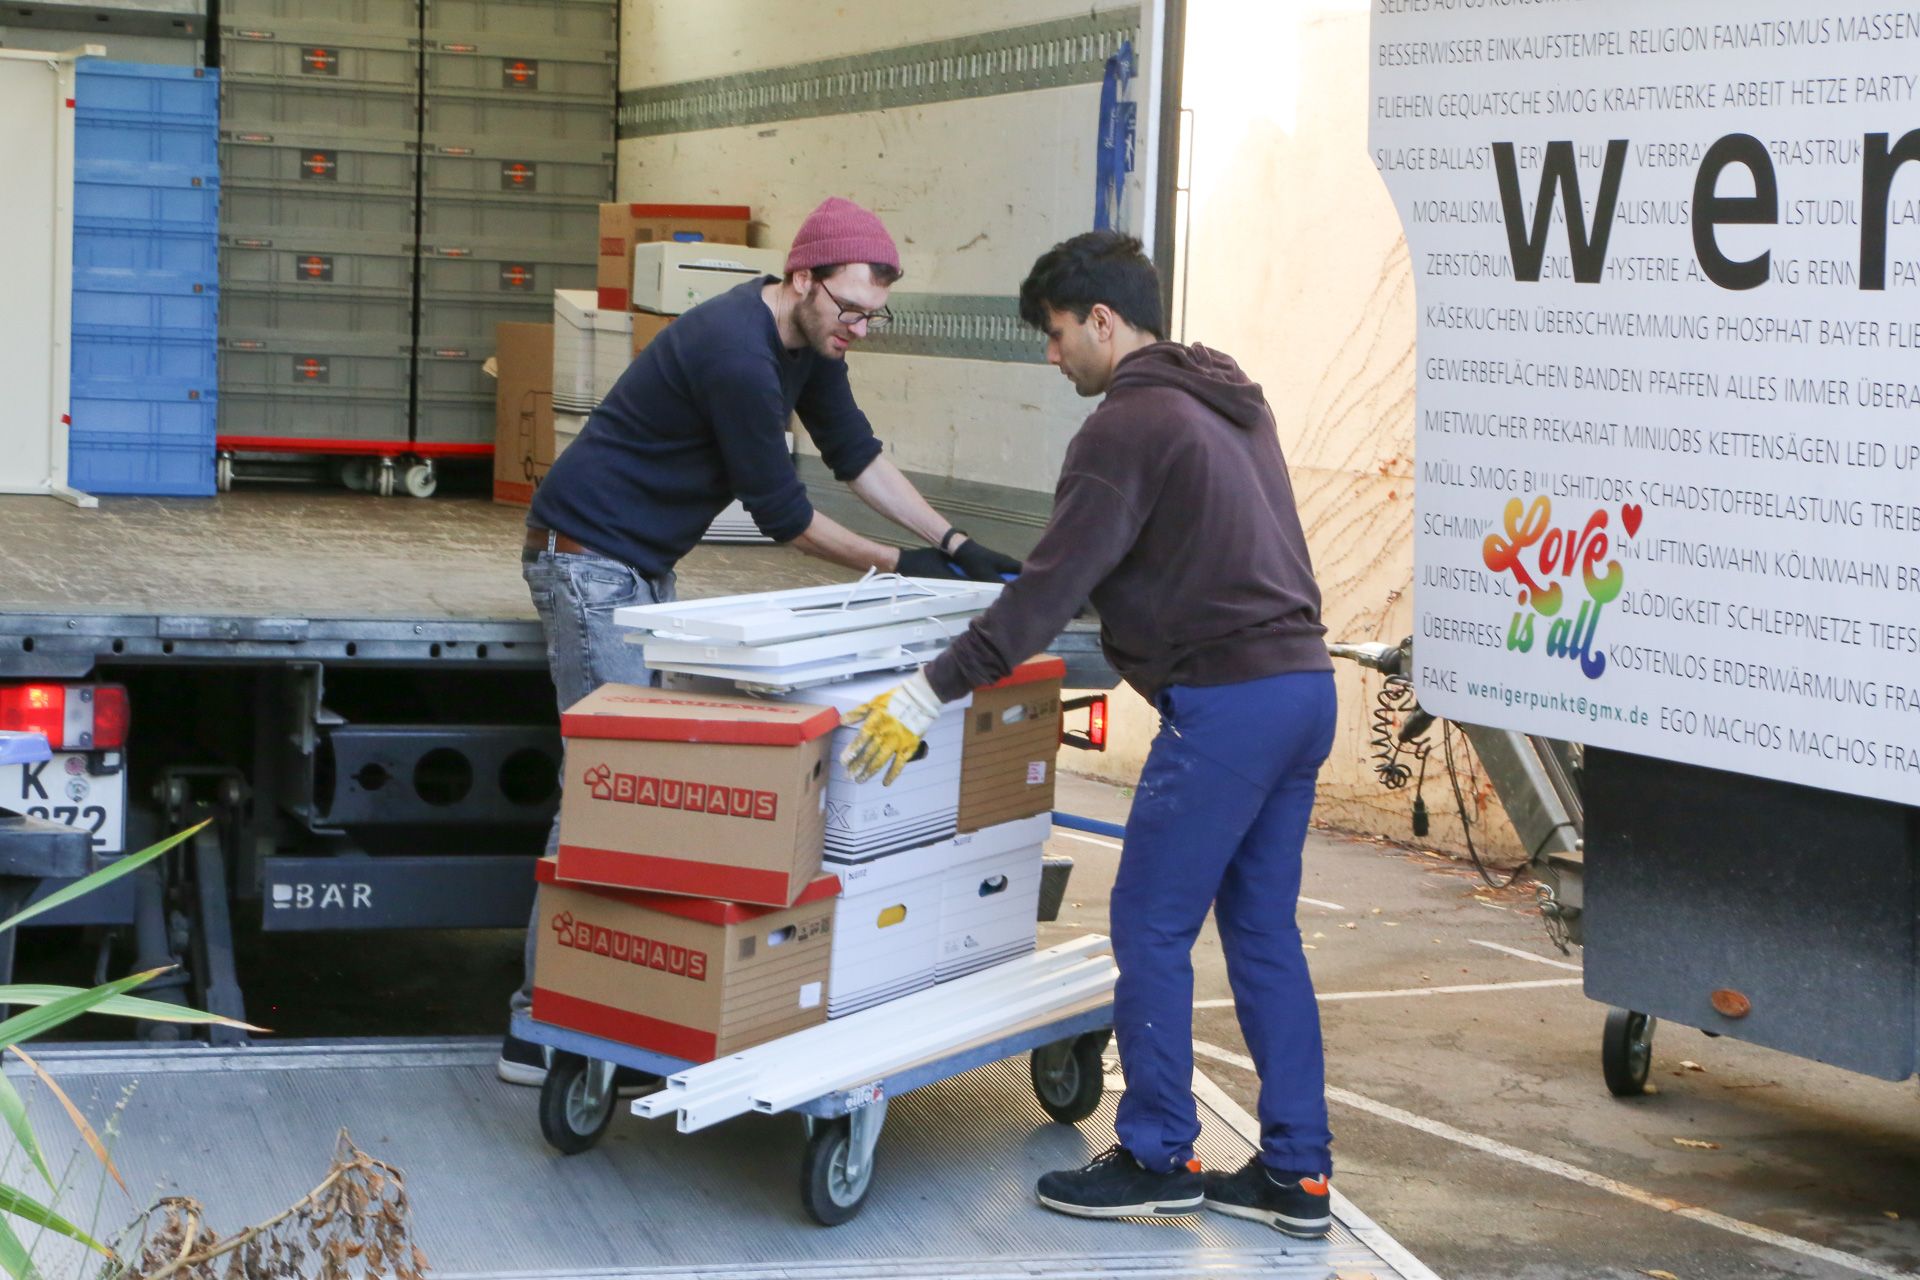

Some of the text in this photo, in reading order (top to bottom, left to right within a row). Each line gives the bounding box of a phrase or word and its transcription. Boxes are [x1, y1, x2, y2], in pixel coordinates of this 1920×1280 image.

[1378, 12, 1920, 66] BESSERWISSER EINKAUFSTEMPEL RELIGION FANATISMUS MASSEN
[1377, 75, 1918, 120] FLIEHEN GEQUATSCHE SMOG KRAFTWERKE ARBEIT HETZE PARTY
[1376, 147, 1425, 171] SILAGE
[1430, 146, 1491, 171] BALLAST
[1635, 143, 1703, 168] VERBRA
[1770, 139, 1862, 166] FRASTRUK
[1412, 200, 1503, 224] MORALISMU
[1616, 200, 1689, 225] ALISMUS
[1785, 200, 1857, 225] LSTUDIU
[1891, 200, 1920, 225] LA
[1427, 250, 1513, 277] ZERSTÖRUN
[1808, 260, 1857, 286] RENN
[1426, 302, 1529, 332] KÄSEKUCHEN
[1534, 304, 1709, 340] ÜBERSCHWEMMUNG
[1716, 315, 1812, 345] PHOSPHAT
[1819, 319, 1880, 348] BAYER
[1426, 357, 1568, 388] GEWERBEFLÄCHEN
[1574, 365, 1642, 393] BANDEN
[1649, 369, 1719, 397] PFAFFEN
[1725, 374, 1777, 402] ALLES
[1784, 377, 1849, 406] IMMER
[1425, 409, 1528, 440] MIETWUCHER
[1533, 417, 1618, 446] PREKARIAT
[1624, 424, 1702, 454] MINIJOBS
[1709, 431, 1839, 465] KETTENSÄGEN
[1847, 440, 1886, 468] LEID
[1424, 459, 1464, 486] MÜLL
[1470, 465, 1517, 492] SMOG
[1639, 481, 1863, 527] SCHADSTOFFBELASTUNG
[1871, 502, 1920, 532] TREIB
[1483, 495, 1624, 616] Love
[1647, 538, 1767, 575] LIFTINGWAHN
[1774, 550, 1889, 589] KÖLNWAHN
[1422, 564, 1489, 595] JURISTEN
[1622, 588, 1721, 626] BLÖDIGKEIT
[1727, 603, 1862, 645] SCHLEPPNETZE
[1869, 622, 1920, 653] TIEFS
[1506, 589, 1606, 679] is all
[1609, 643, 1707, 681] KOSTENLOS
[1713, 658, 1877, 708] ERDERWÄRMUNG
[1422, 666, 1457, 693] FAKE
[1467, 679, 1649, 726] wenigerpunkt@gmx.de
[1660, 706, 1697, 735] EGO
[1703, 713, 1782, 750] NACHOS
[1789, 728, 1877, 767] MACHOS
[22, 760, 49, 799] K
[615, 775, 776, 819] BAUHAUS
[296, 883, 372, 908] BÄR
[576, 923, 706, 979] BAUHAUS
